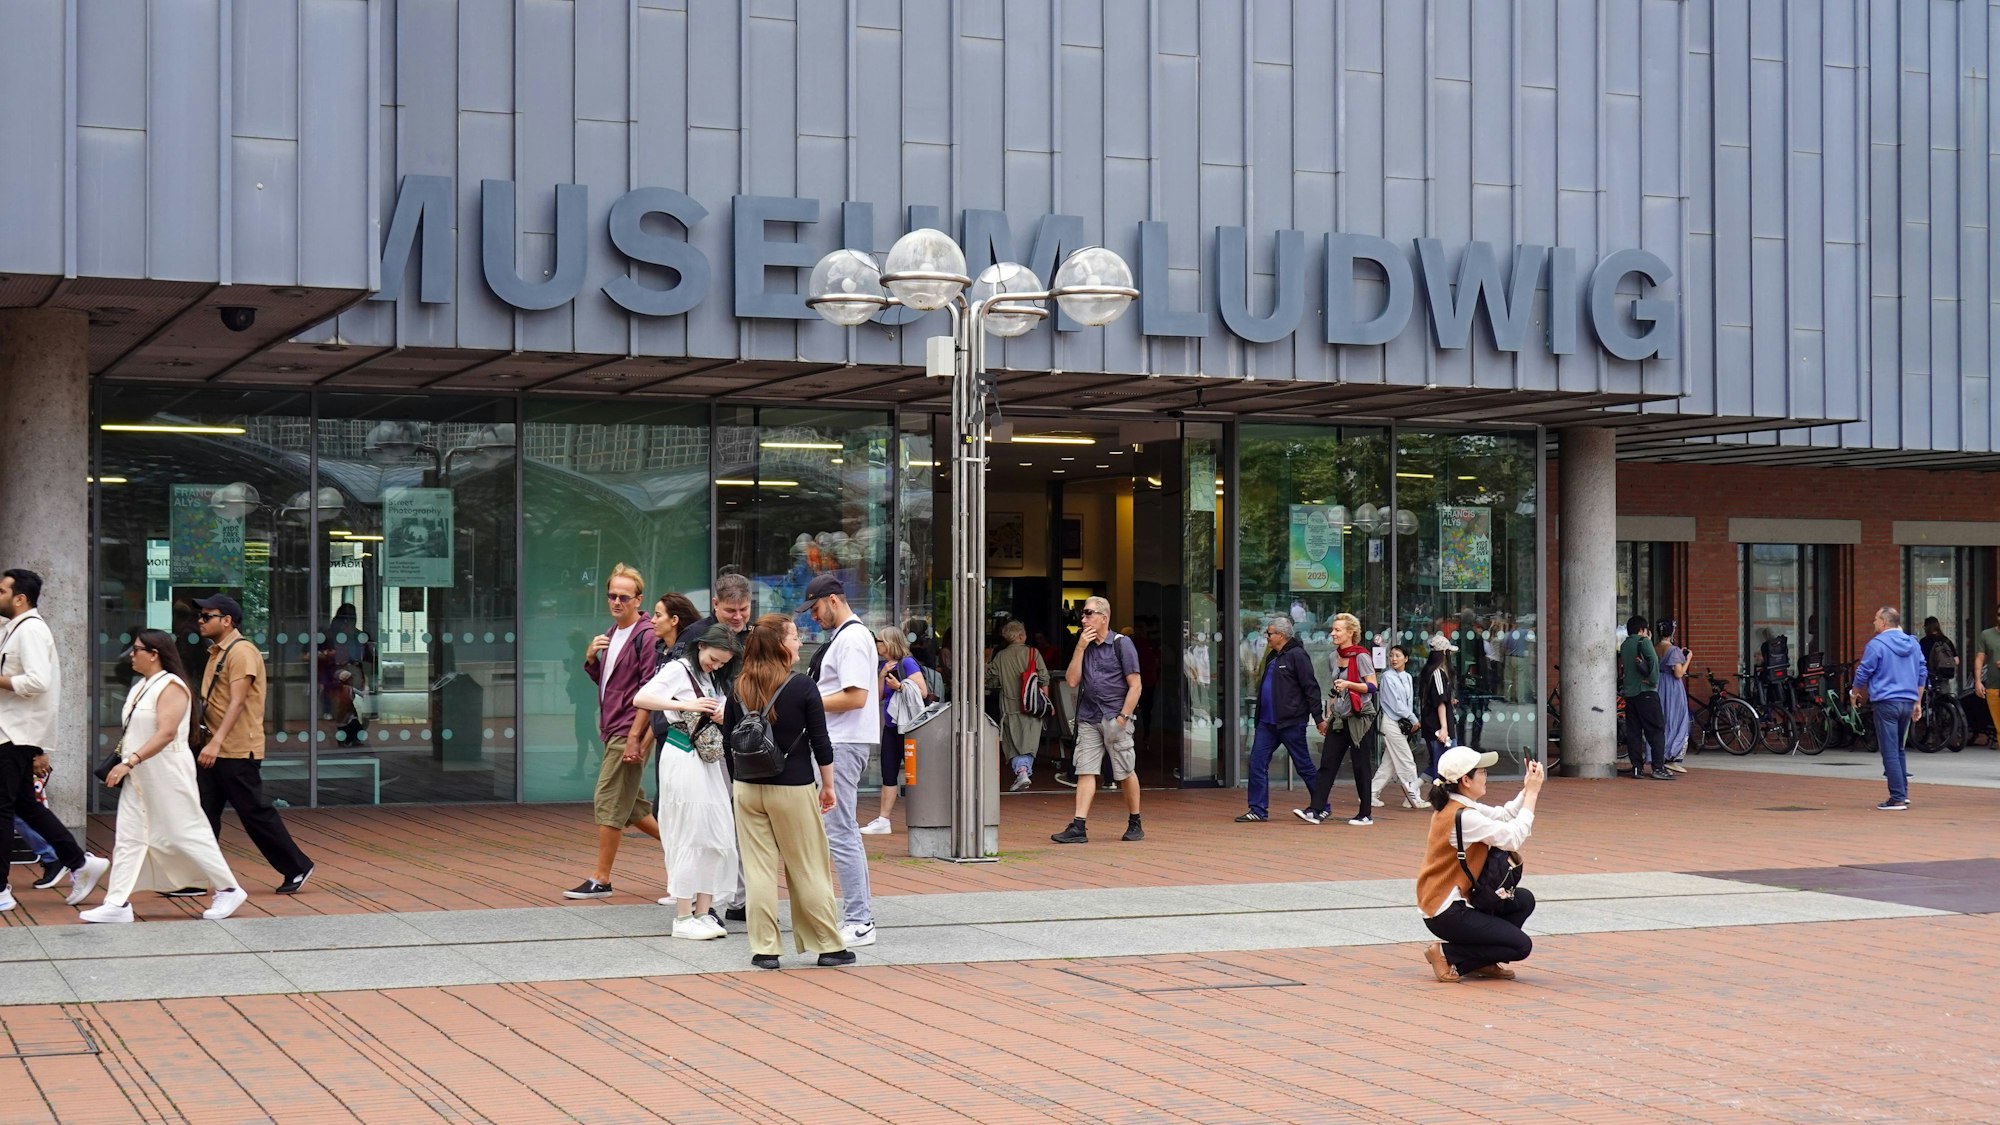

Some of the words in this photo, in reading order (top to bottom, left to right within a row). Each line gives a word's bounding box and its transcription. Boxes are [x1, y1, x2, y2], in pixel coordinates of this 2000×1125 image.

[1138, 220, 1676, 361] LUDWIG
[388, 507, 442, 516] Photography
[1442, 510, 1476, 518] FRANCIS
[1307, 572, 1327, 580] 2025
